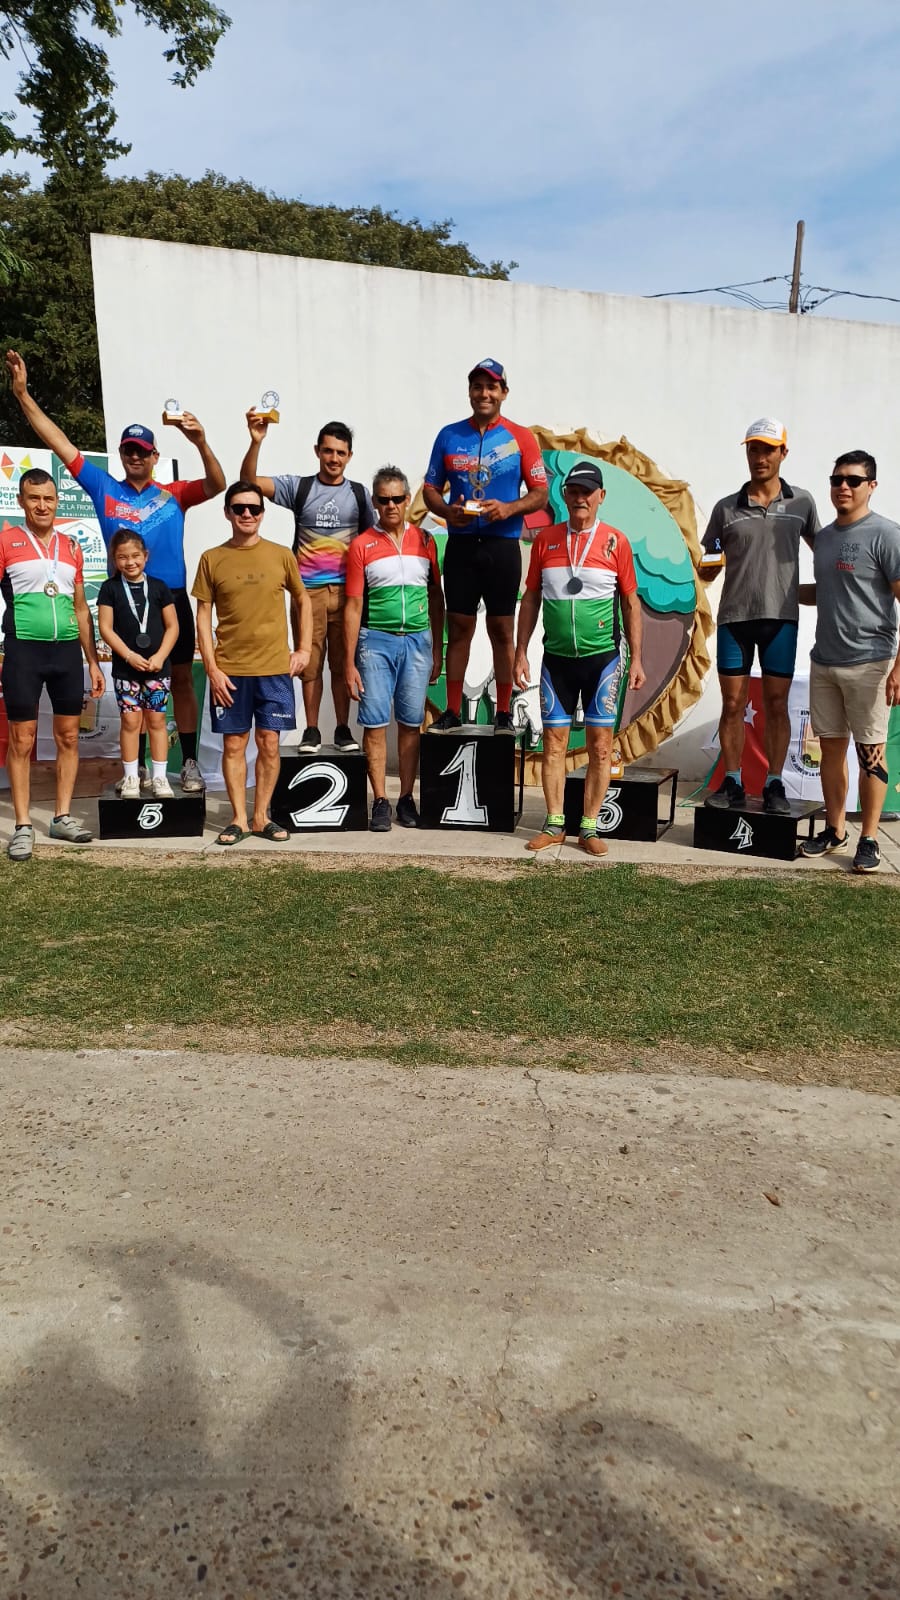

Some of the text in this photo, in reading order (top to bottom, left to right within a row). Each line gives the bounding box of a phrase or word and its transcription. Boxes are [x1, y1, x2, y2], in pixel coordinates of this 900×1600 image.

[58, 492, 76, 501] San
[315, 520, 340, 528] BIKE
[288, 761, 350, 827] 2
[440, 741, 489, 826] 1
[137, 803, 163, 830] 5
[600, 787, 623, 832] 3
[729, 816, 754, 850] 4
